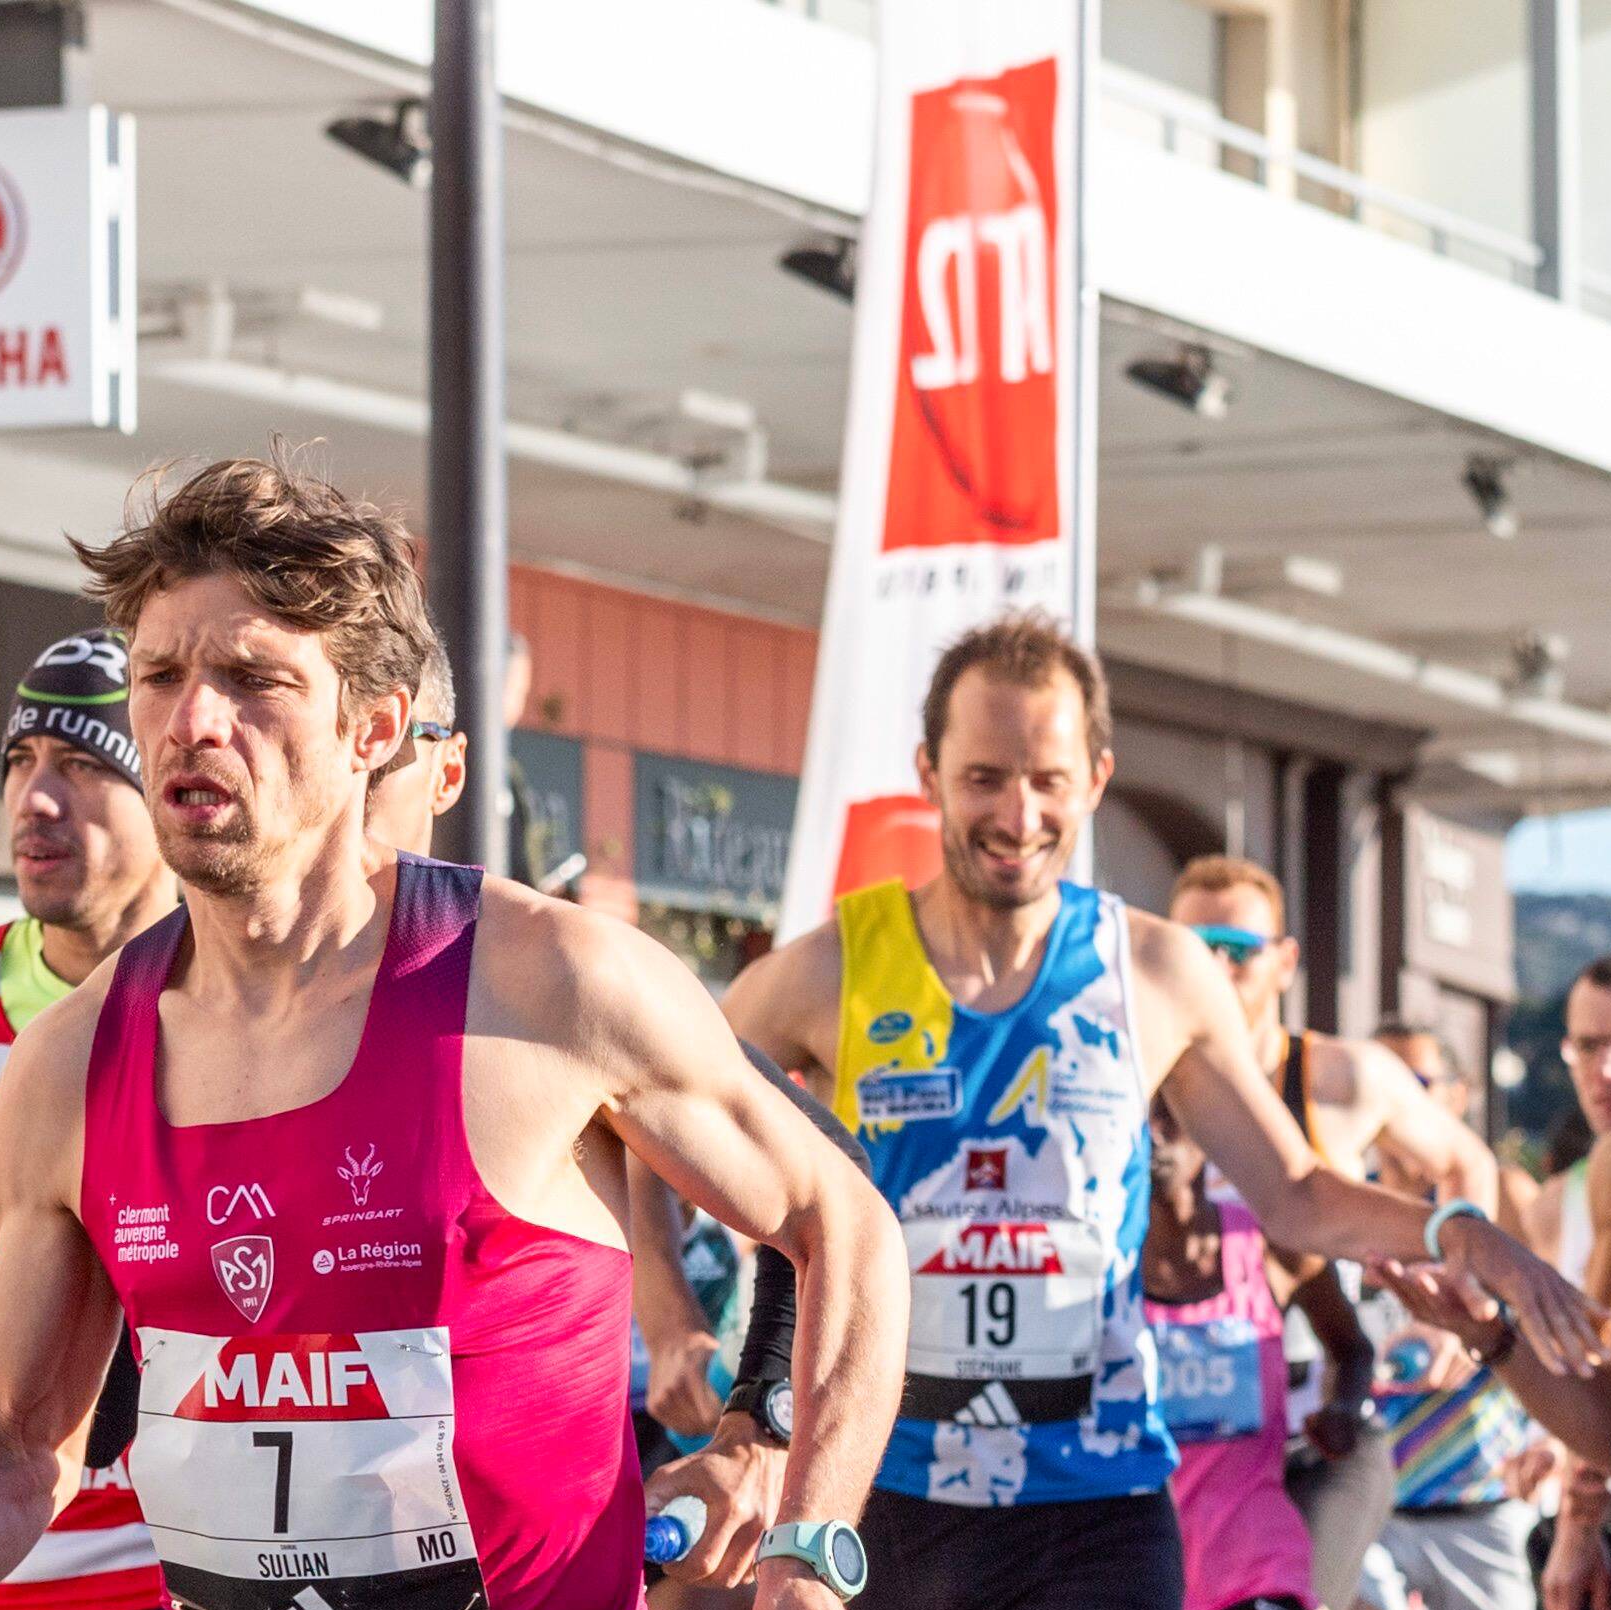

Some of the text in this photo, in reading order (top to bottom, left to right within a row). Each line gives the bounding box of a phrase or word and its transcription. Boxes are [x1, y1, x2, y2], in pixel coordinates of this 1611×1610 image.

[117, 1203, 170, 1226] clermont
[321, 1208, 404, 1227] SPRINGART
[114, 1224, 166, 1244] auvergne
[943, 1230, 1054, 1270] MAIF
[117, 1240, 180, 1265] métropole
[337, 1241, 422, 1261] La Région
[959, 1282, 1017, 1348] 19
[203, 1351, 370, 1408] MAIF
[251, 1430, 293, 1534] 7
[257, 1530, 458, 1578] SULIAN MO
